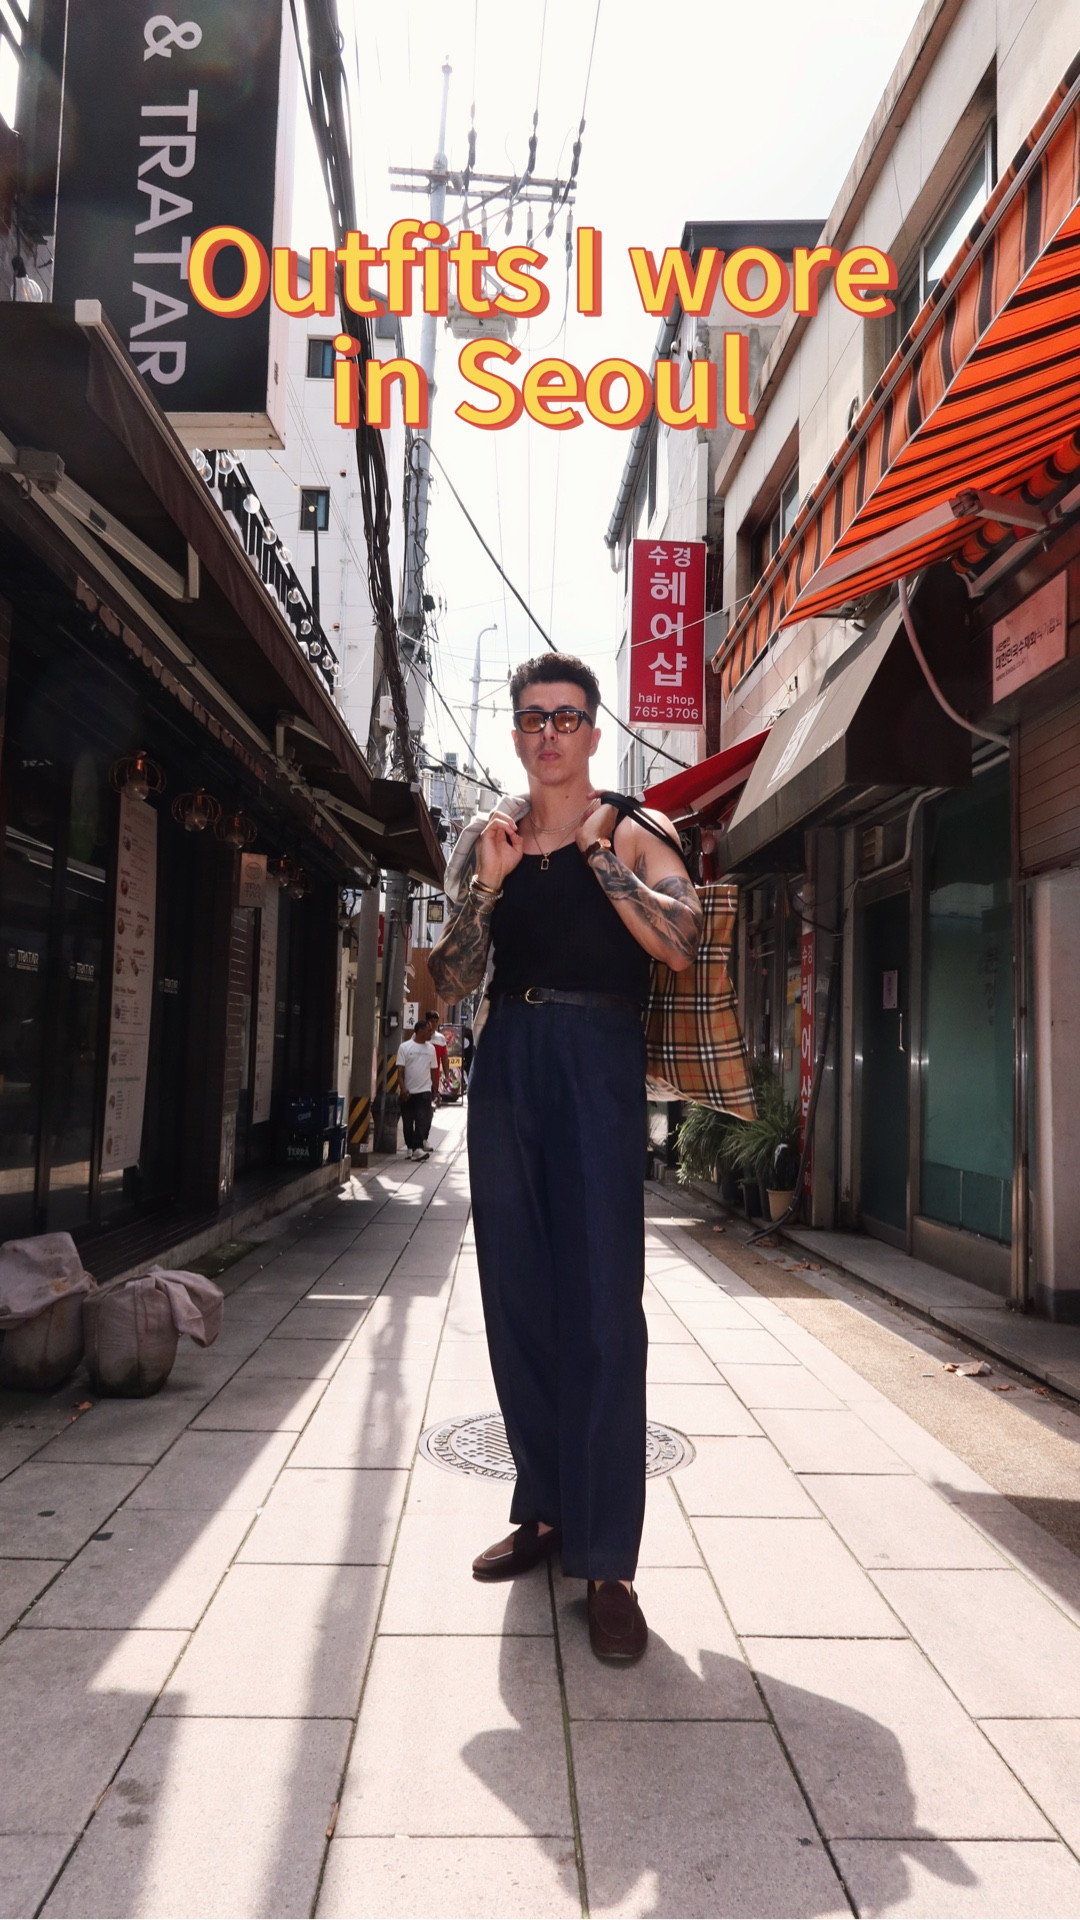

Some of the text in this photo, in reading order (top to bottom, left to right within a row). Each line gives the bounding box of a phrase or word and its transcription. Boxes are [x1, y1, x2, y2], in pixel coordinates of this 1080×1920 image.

[129, 14, 203, 386] & TRATAR
[648, 545, 691, 568] 수경
[647, 571, 688, 687] 헤어샵
[638, 692, 695, 707] hair shop
[634, 706, 699, 720] 765-3706
[17, 949, 39, 965] TRATAR
[801, 945, 814, 966] 수경
